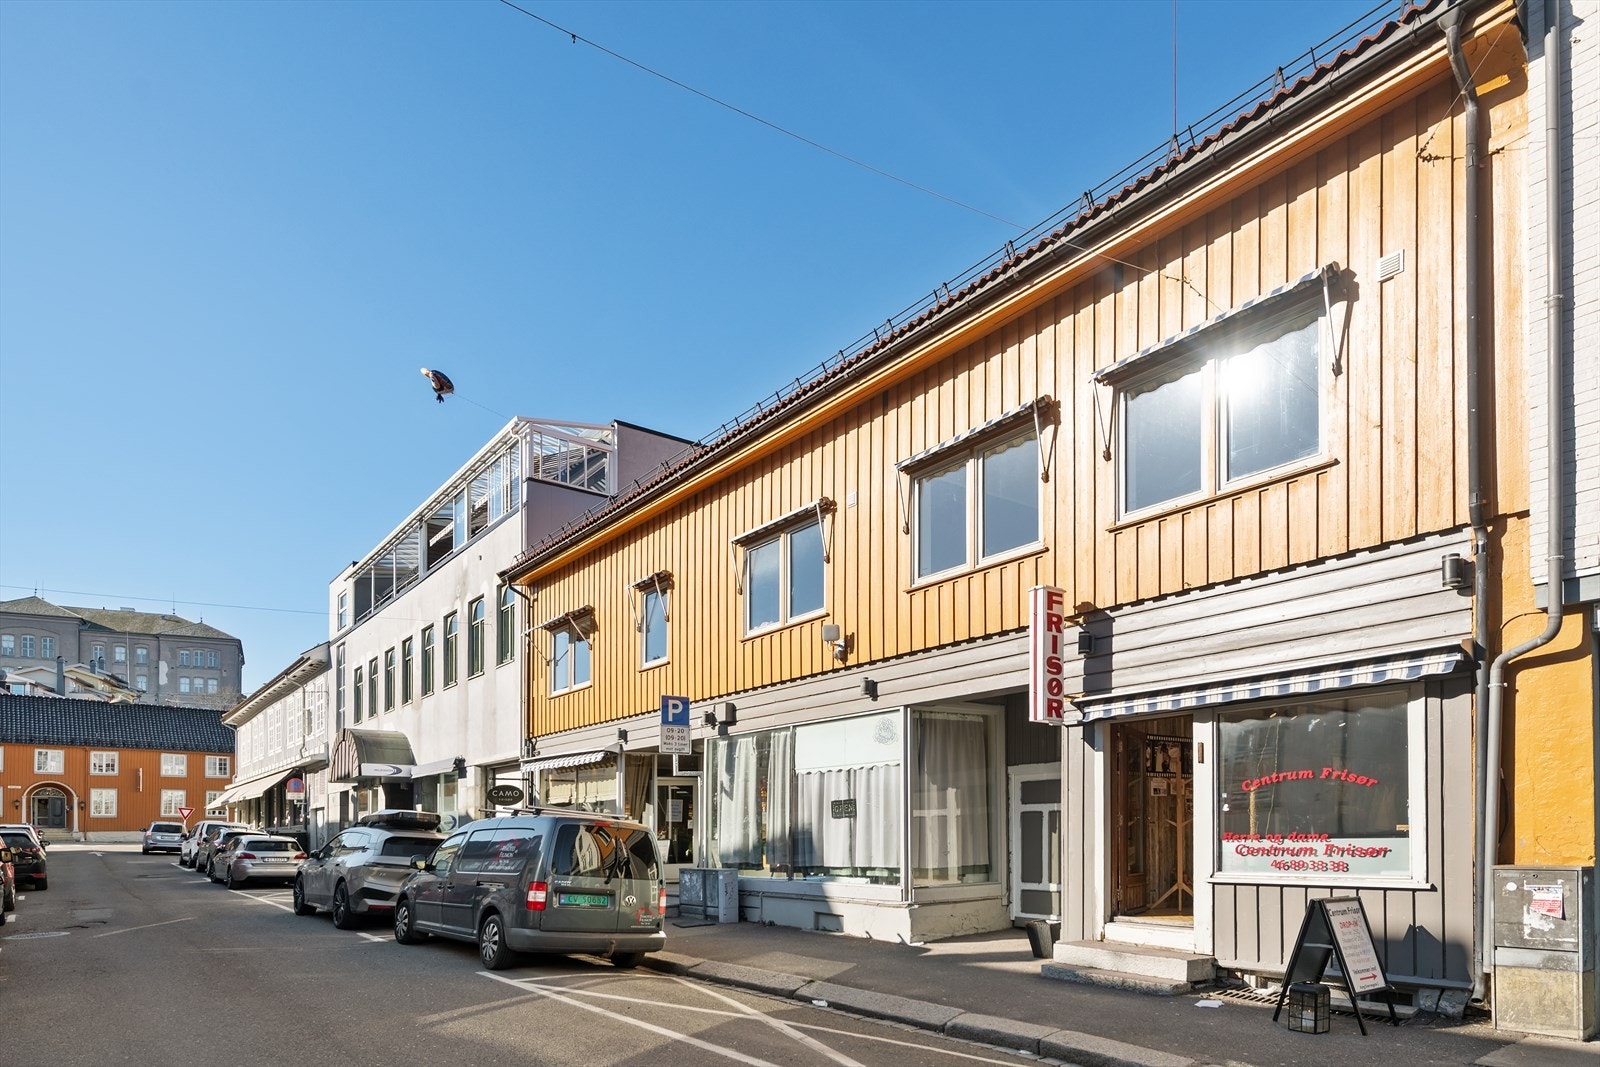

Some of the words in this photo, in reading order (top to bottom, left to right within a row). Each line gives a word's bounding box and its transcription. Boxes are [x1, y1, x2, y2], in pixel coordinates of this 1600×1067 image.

[1046, 591, 1063, 718] FRISØR
[668, 699, 684, 722] P
[1241, 768, 1314, 792] Centrum
[1319, 767, 1379, 788] Frisør
[1264, 833, 1284, 845] og
[1286, 831, 1330, 842] dame
[1235, 842, 1315, 857] Centrum
[1322, 842, 1389, 858] Frisør
